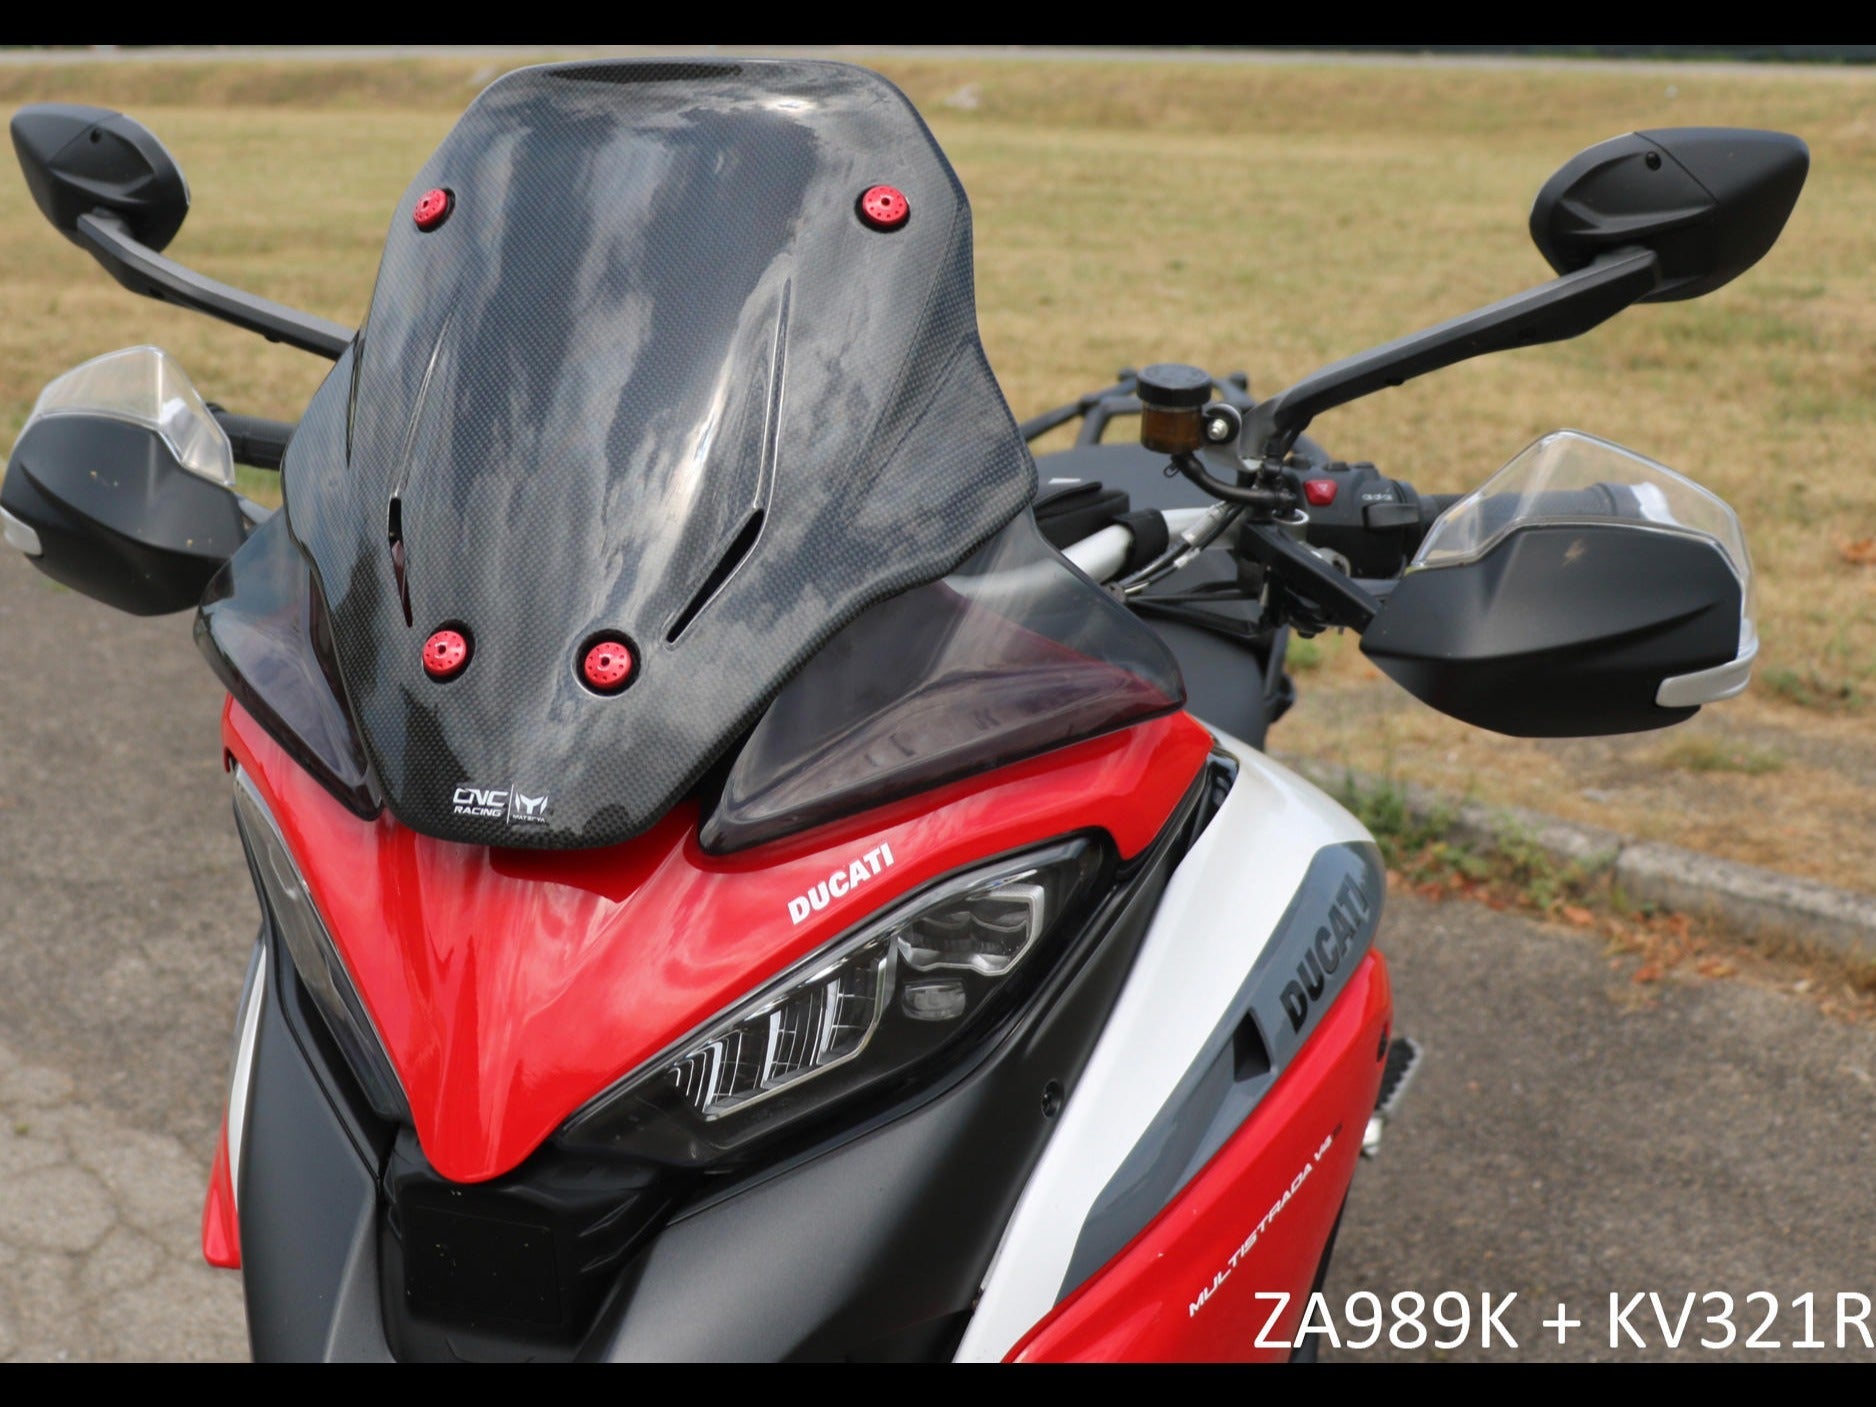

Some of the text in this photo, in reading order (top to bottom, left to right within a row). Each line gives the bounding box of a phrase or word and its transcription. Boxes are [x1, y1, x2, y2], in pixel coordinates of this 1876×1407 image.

[453, 787, 509, 808] CNC
[454, 805, 503, 818] RACING
[787, 842, 895, 926] DUCATI
[1279, 873, 1370, 1035] DUCATI
[1188, 1162, 1313, 1318] MULTISTRADA
